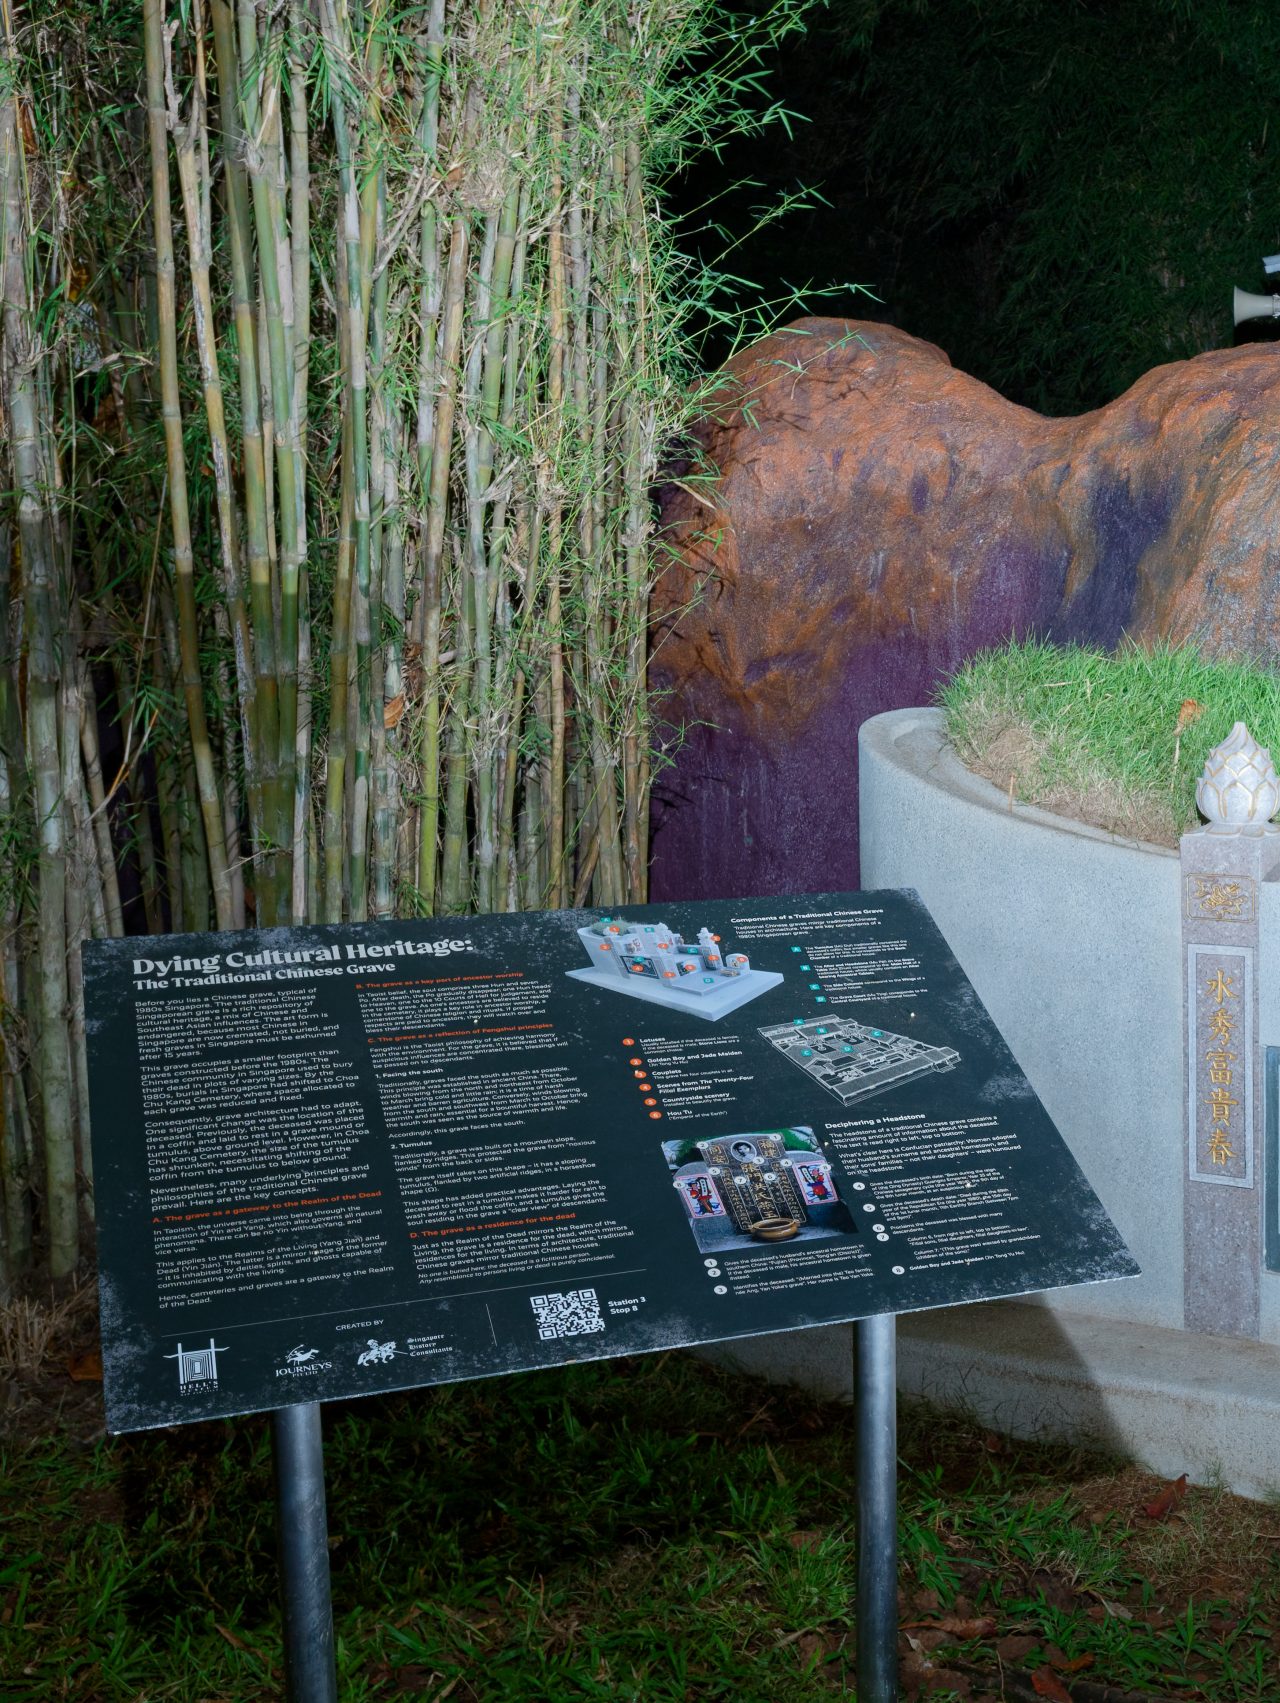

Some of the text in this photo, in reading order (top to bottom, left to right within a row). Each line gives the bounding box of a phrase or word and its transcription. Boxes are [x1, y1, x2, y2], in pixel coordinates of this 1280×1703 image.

[133, 938, 475, 977] Dying Cultural Heritage:
[133, 963, 396, 990] The Traditional Chinese Grave
[277, 988, 306, 996] typical
[165, 1003, 210, 1011] Singapore.
[234, 997, 279, 1005] traditional
[136, 1012, 192, 1020] Singaporean
[136, 1019, 170, 1027] cultural
[137, 1025, 183, 1034] Southeast
[137, 1030, 194, 1040] endangered,
[138, 1039, 185, 1047] Singapore
[226, 1030, 271, 1039] cremated,
[208, 1039, 254, 1047] Singapore
[295, 1031, 336, 1040] exhumed
[1203, 970, 1239, 1165] 水秀富貴春
[662, 1095, 703, 1103] Countryside
[824, 1119, 875, 1129] Deciphering
[882, 1114, 926, 1123] Headstone
[388, 1130, 432, 1139] Accordingly,
[185, 1212, 210, 1221] grave
[233, 1206, 270, 1215] gateway
[440, 1228, 464, 1236] grave
[484, 1220, 524, 1229] residence
[187, 1297, 211, 1305] Dead.
[608, 1299, 639, 1307] Station
[610, 1307, 631, 1315] Stop
[336, 1321, 372, 1331] CREATED
[276, 1362, 332, 1377] JOURNEYS
